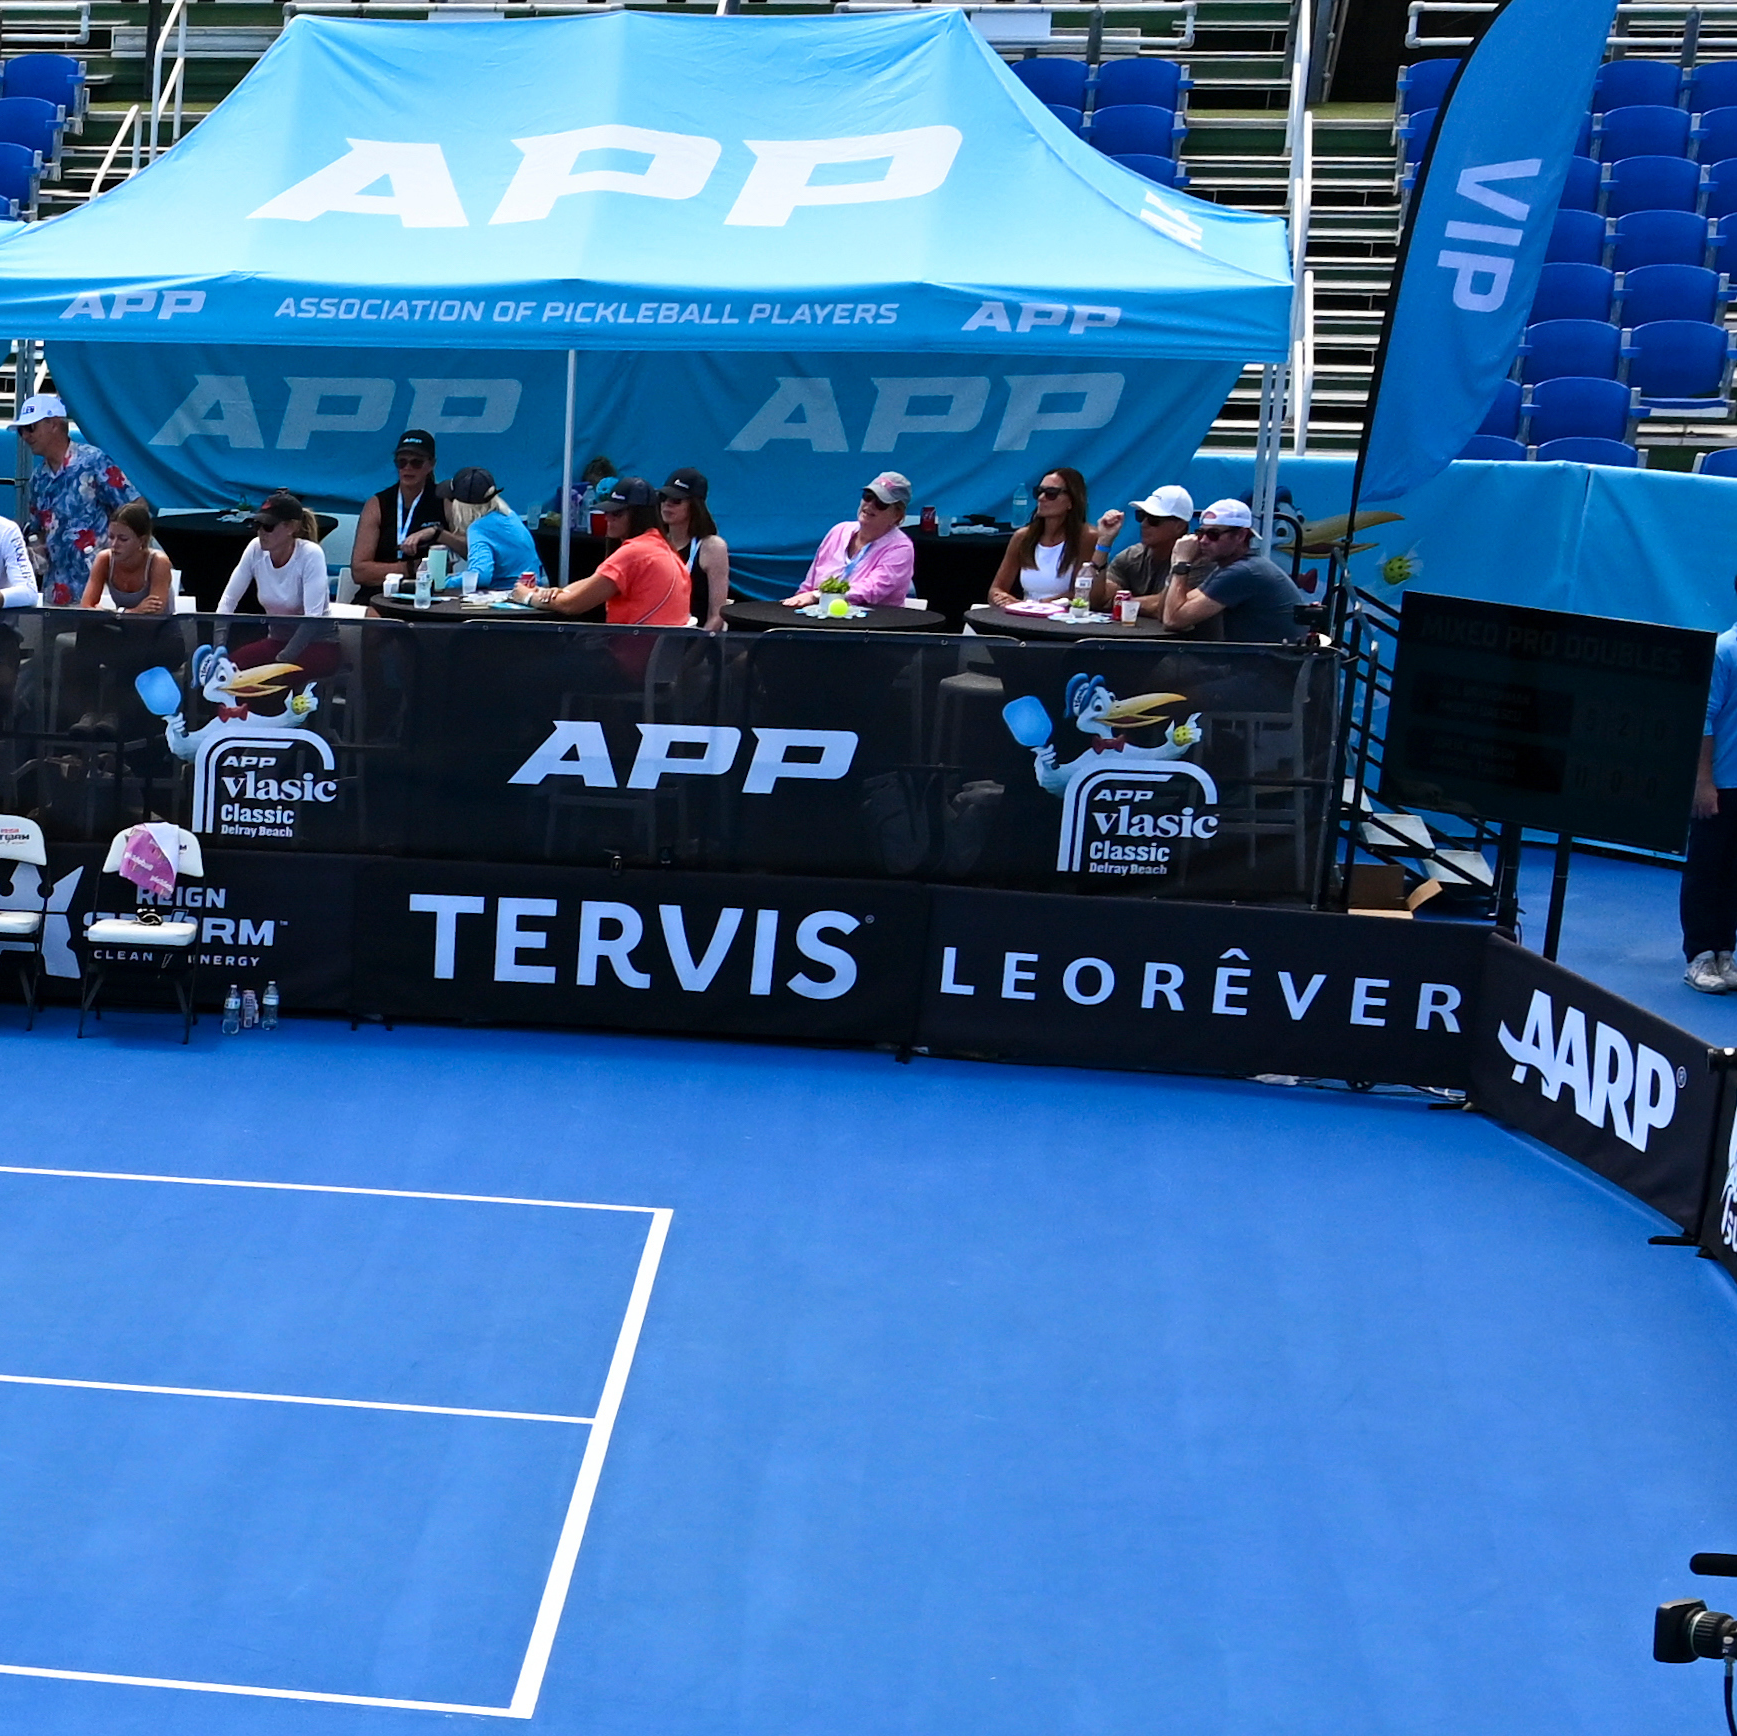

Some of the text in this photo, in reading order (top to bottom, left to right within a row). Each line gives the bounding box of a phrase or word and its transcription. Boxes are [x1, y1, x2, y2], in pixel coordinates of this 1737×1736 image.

[247, 124, 965, 230] APP
[1437, 158, 1542, 313] VIP
[59, 289, 207, 320] APP
[273, 297, 900, 327] ASSOCIATION OF PICKLEBALL PLAYERS
[961, 301, 1122, 335] APP
[148, 374, 524, 451] APP
[726, 371, 1127, 454] APP
[221, 756, 277, 768] APP
[507, 719, 859, 795] APP
[222, 772, 338, 803] vlasic
[1093, 788, 1154, 801] APP
[221, 804, 295, 825] Classic
[1090, 805, 1219, 841] vlasic
[221, 824, 294, 839] Delray Beach
[1089, 841, 1171, 863] Classic
[1088, 861, 1168, 876] Delray Beach
[94, 949, 153, 962] CLEAN
[410, 893, 861, 1000] TERVIS
[940, 947, 1463, 1035] LEORÊVER
[1498, 989, 1678, 1153] AARP
